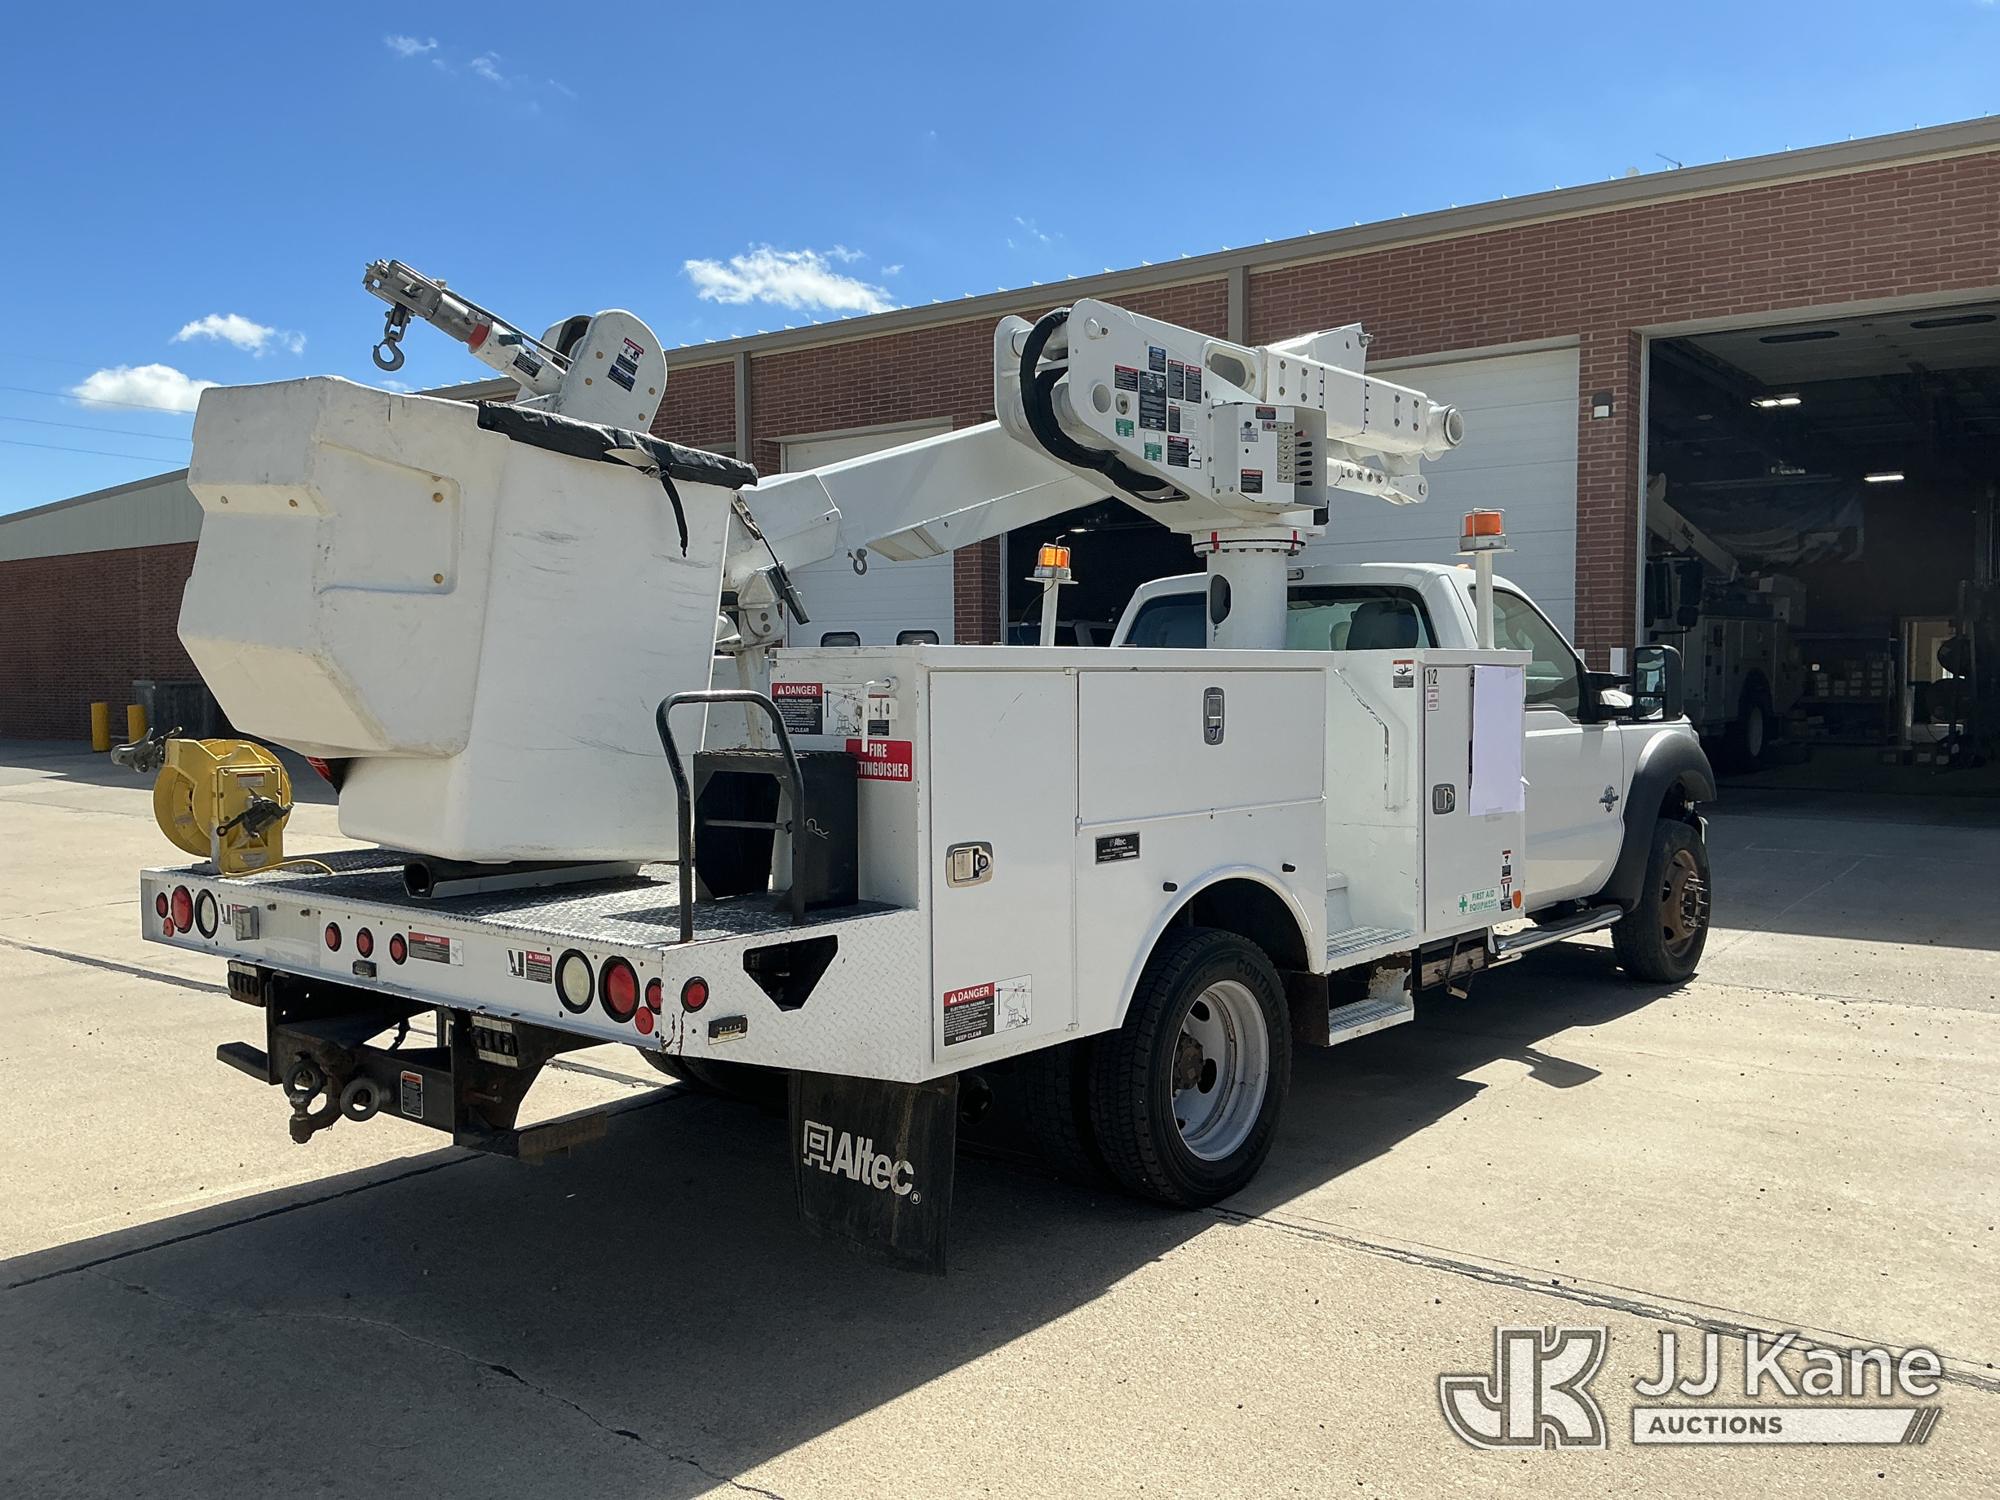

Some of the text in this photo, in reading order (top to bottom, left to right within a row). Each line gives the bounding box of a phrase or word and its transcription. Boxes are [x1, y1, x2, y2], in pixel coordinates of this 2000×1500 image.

[785, 685, 817, 695] DANGER
[869, 743, 887, 757] FIRE
[857, 761, 909, 778] TINGUISHER
[1472, 889, 1494, 901] FIRST AID
[958, 986, 989, 1001] DANGER
[967, 1031, 982, 1039] CLEAR
